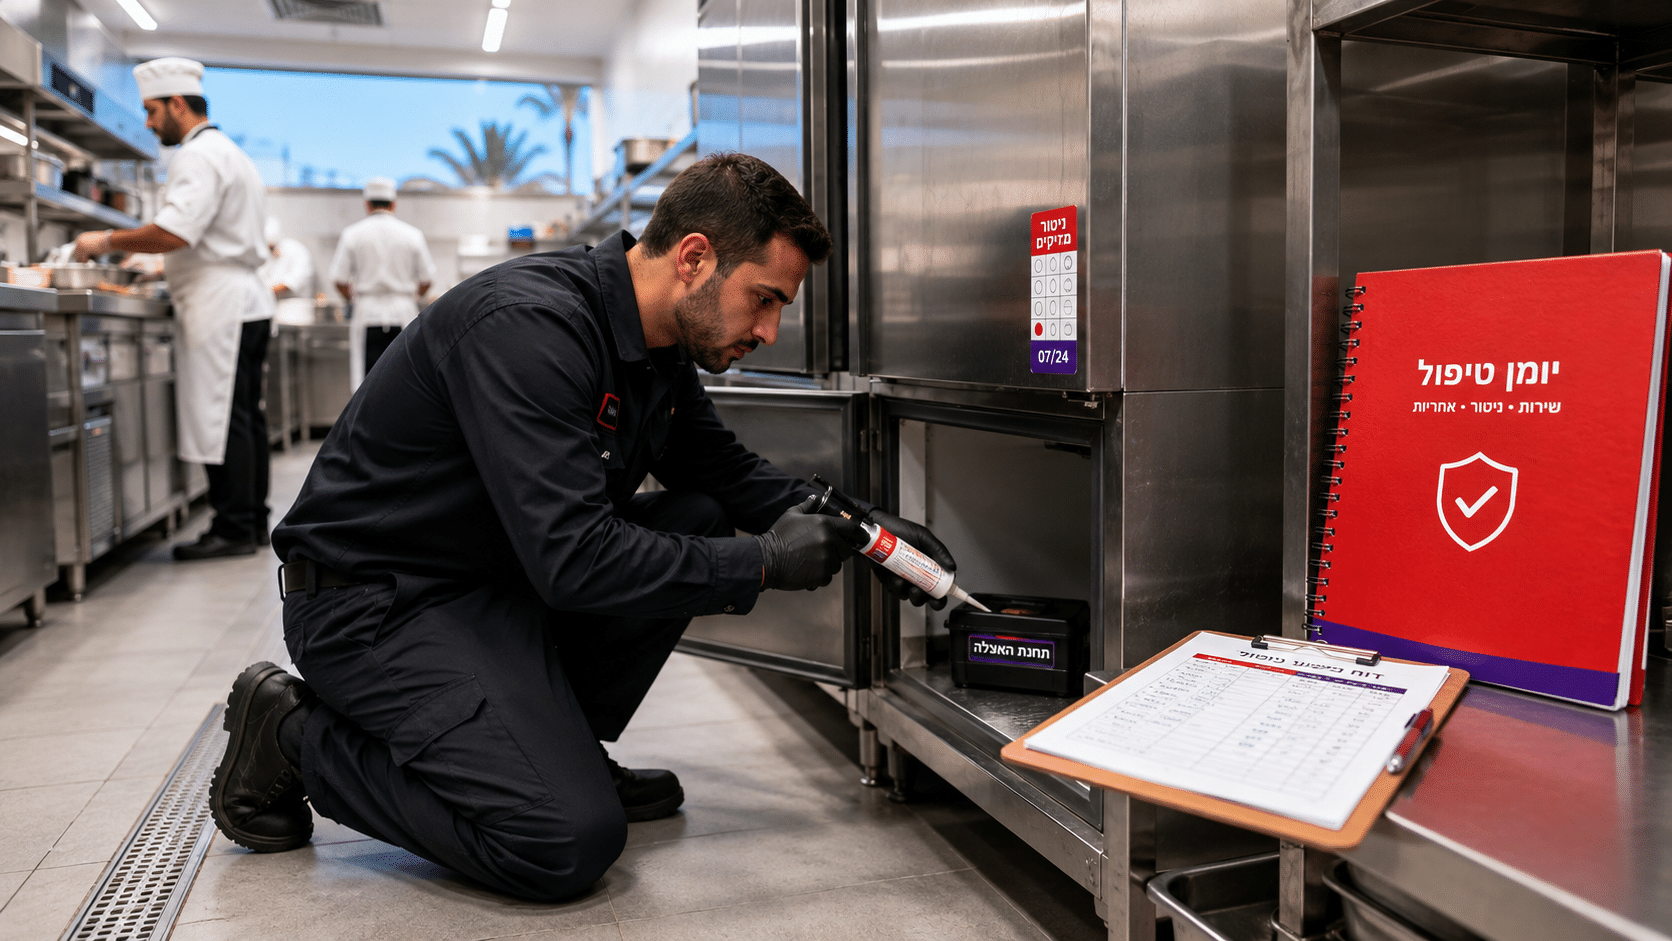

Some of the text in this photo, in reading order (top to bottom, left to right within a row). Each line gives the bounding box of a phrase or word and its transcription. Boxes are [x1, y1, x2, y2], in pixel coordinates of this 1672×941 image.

[1040, 217, 1066, 233] ניטור
[1036, 233, 1072, 251] מזיקים
[1038, 349, 1069, 365] 07/24
[1417, 358, 1560, 393] יומן טיפול
[1412, 401, 1562, 414] שירות ניטור אחריות
[973, 640, 1050, 660] תחנת האצלה
